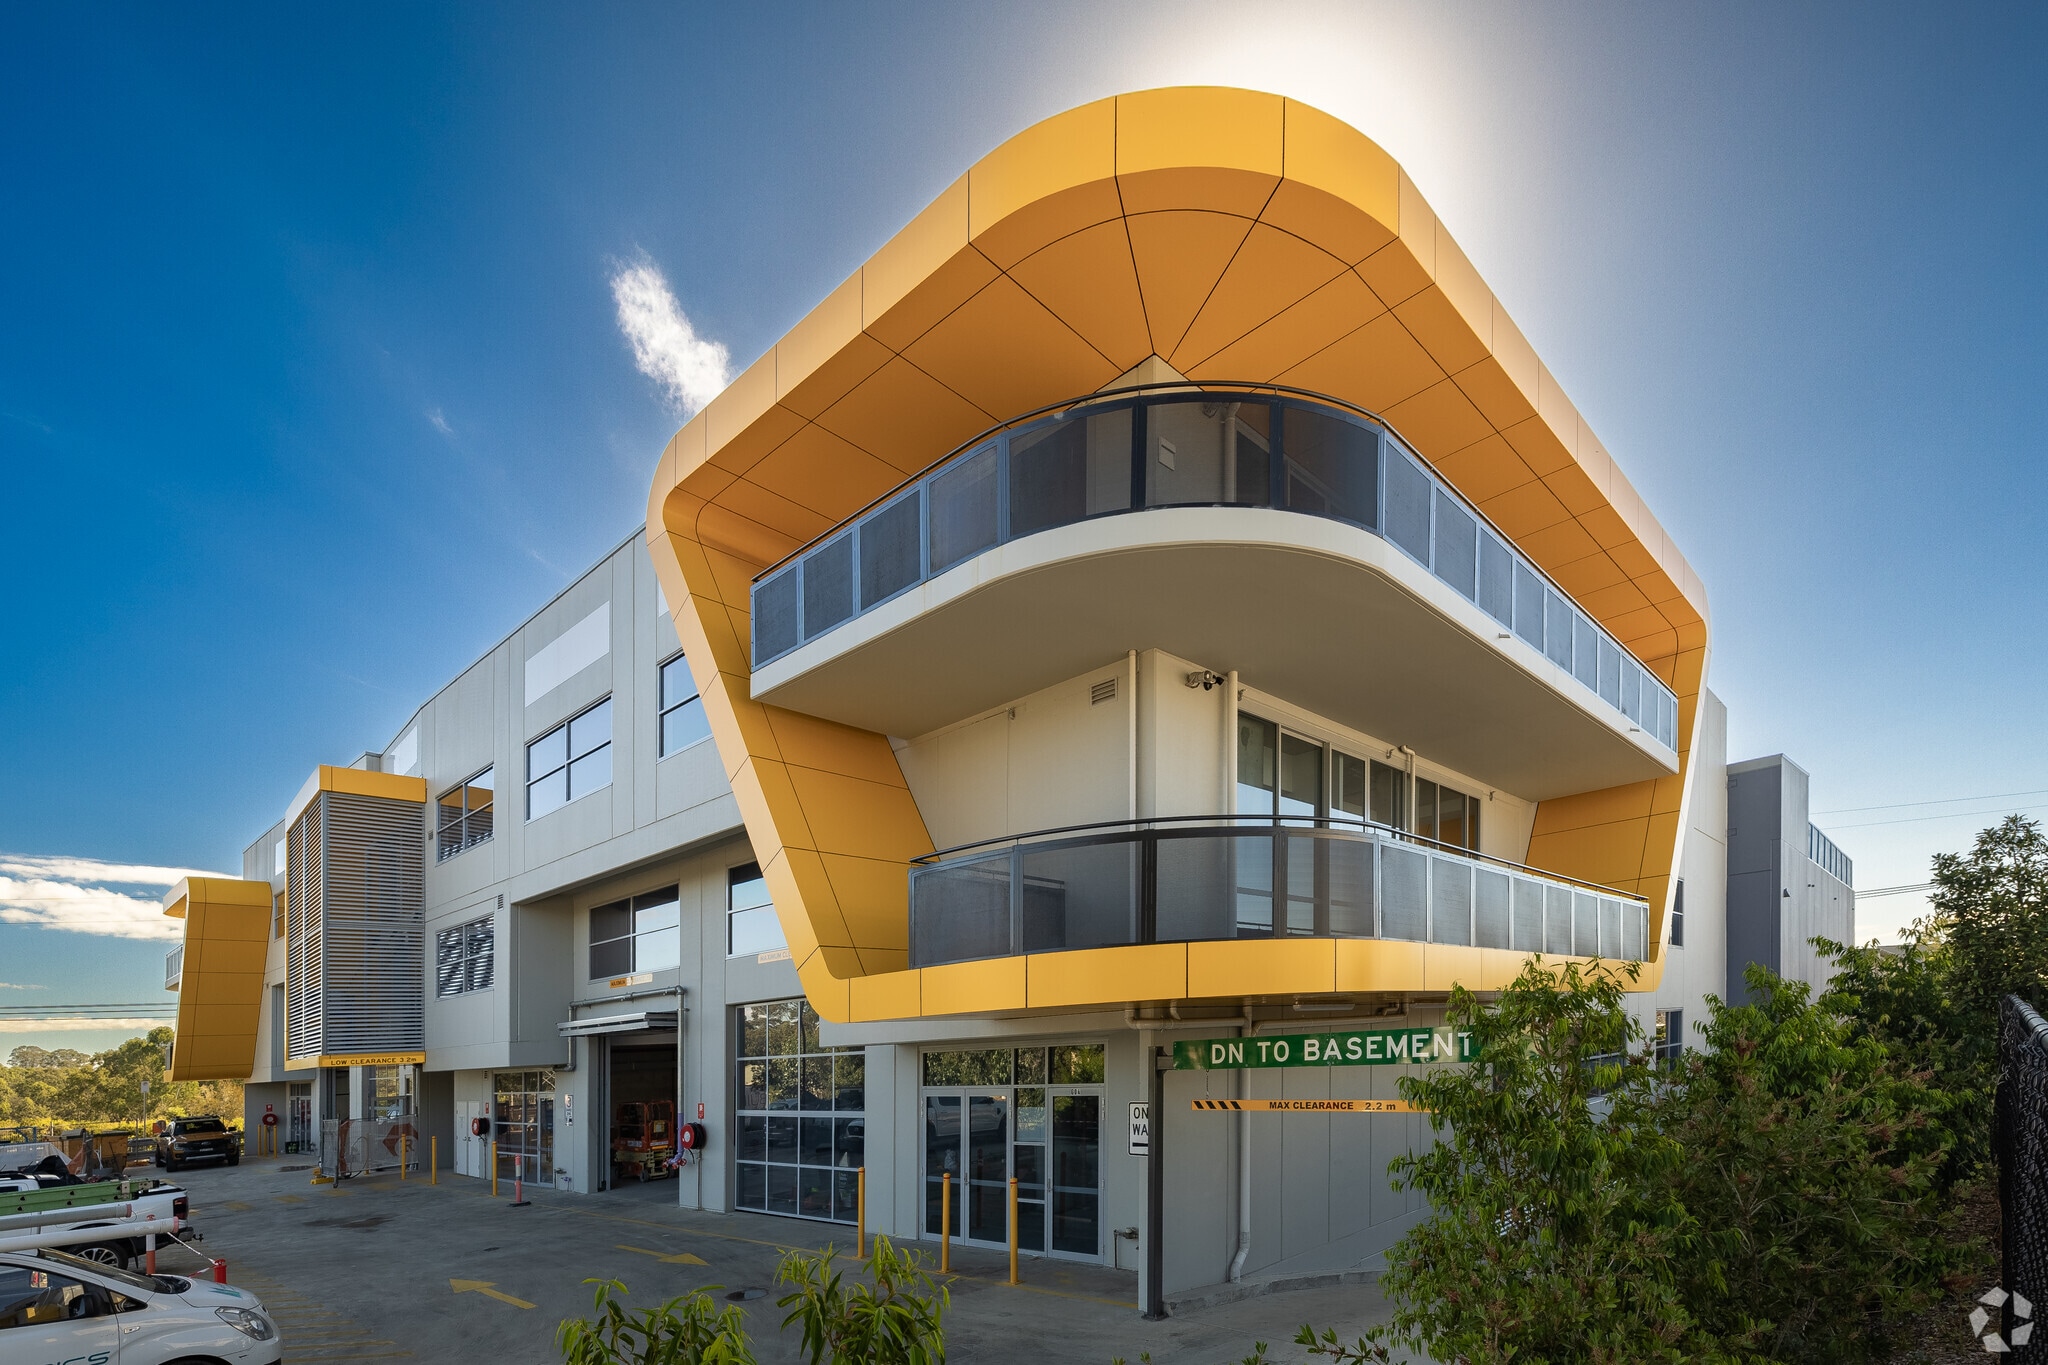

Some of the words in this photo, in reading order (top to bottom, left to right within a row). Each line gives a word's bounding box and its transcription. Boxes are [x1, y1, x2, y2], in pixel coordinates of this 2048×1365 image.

[1211, 1043, 1243, 1064] DN
[1257, 1041, 1289, 1063] TO
[1304, 1032, 1473, 1061] BASEMENT
[350, 1057, 396, 1065] CLEARANCE
[1269, 1101, 1290, 1109] MAX
[1293, 1101, 1354, 1110] CLEARANCE
[1365, 1102, 1383, 1110] 2.2
[1133, 1107, 1148, 1119] ON
[1132, 1123, 1148, 1136] WA
